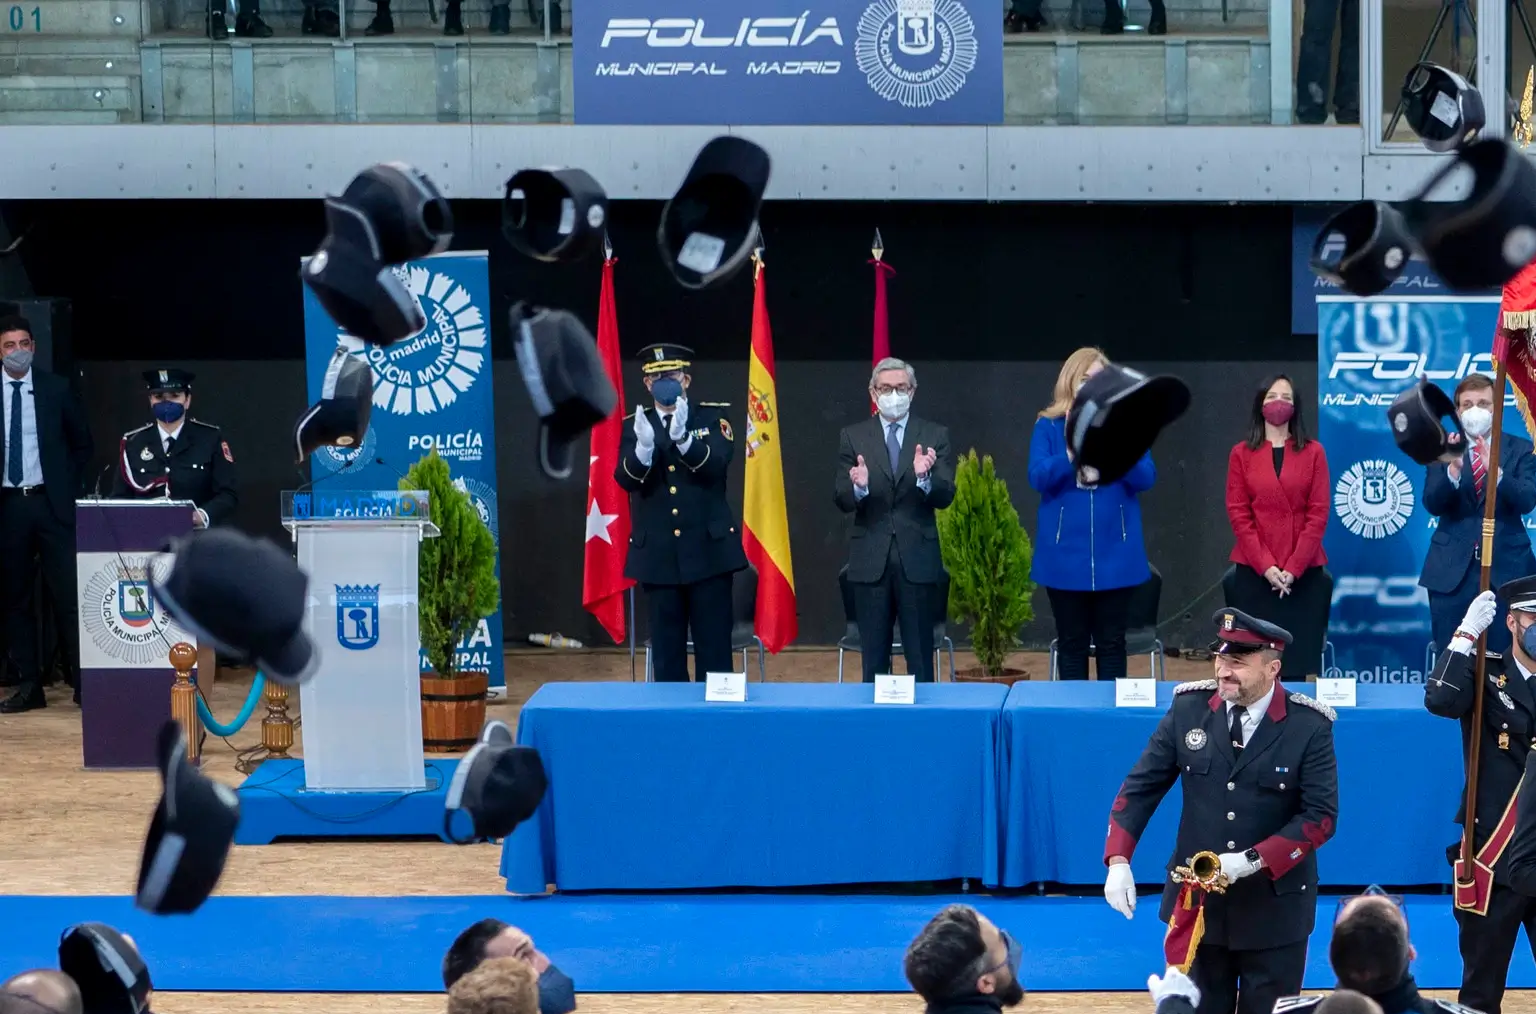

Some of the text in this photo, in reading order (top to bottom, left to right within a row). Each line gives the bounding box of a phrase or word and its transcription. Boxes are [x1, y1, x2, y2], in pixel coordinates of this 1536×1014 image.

[600, 10, 844, 48] POLICÍA
[595, 60, 842, 76] MUNICIPAL MADRID
[880, 21, 952, 82] POLICÍA MUNICIPAL MADRID
[369, 303, 457, 386] OLICIA MUNICIPAL
[389, 330, 441, 362] madrid
[1328, 353, 1497, 380] POLIC
[408, 429, 483, 450] POLICÍA
[102, 587, 164, 642] POLICÍA MUNICIPAL
